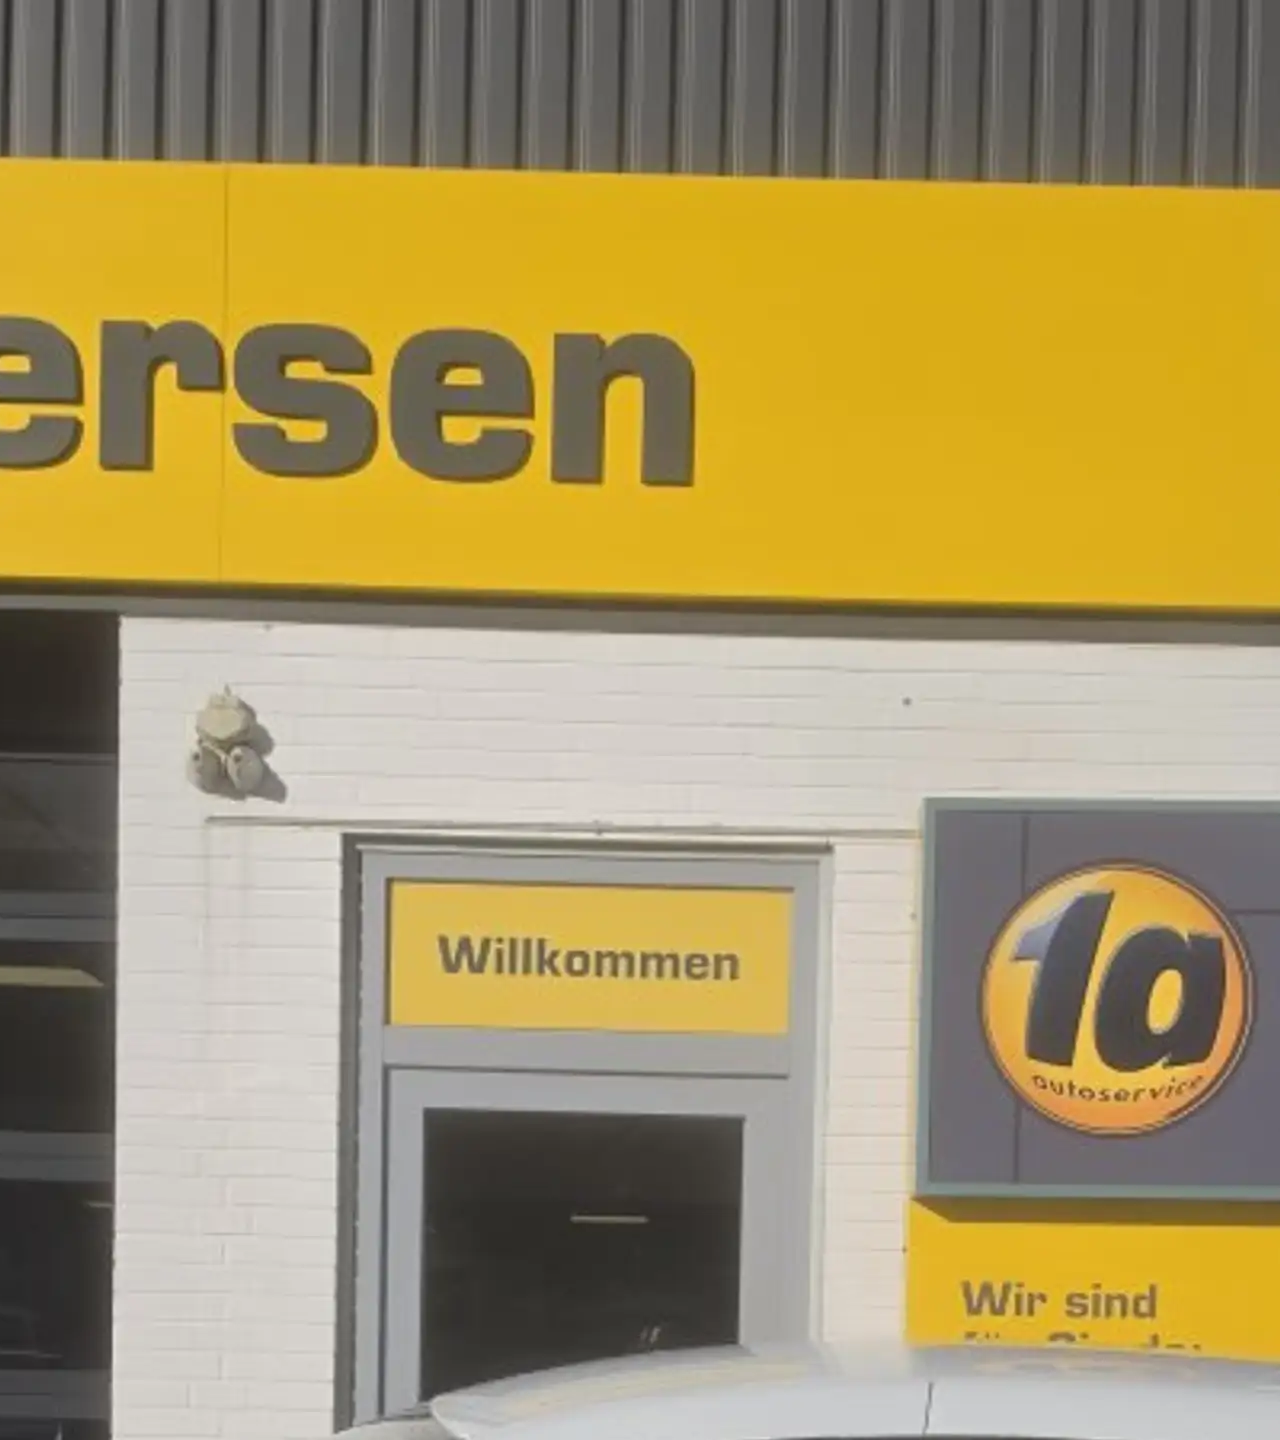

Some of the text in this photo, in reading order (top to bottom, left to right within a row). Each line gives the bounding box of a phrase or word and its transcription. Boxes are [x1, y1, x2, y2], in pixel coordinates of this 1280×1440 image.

[437, 934, 740, 981] Willkommen
[1010, 889, 1227, 1073] 1a
[1032, 1073, 1204, 1103] autoservice
[961, 1279, 1159, 1320] Wir sind
